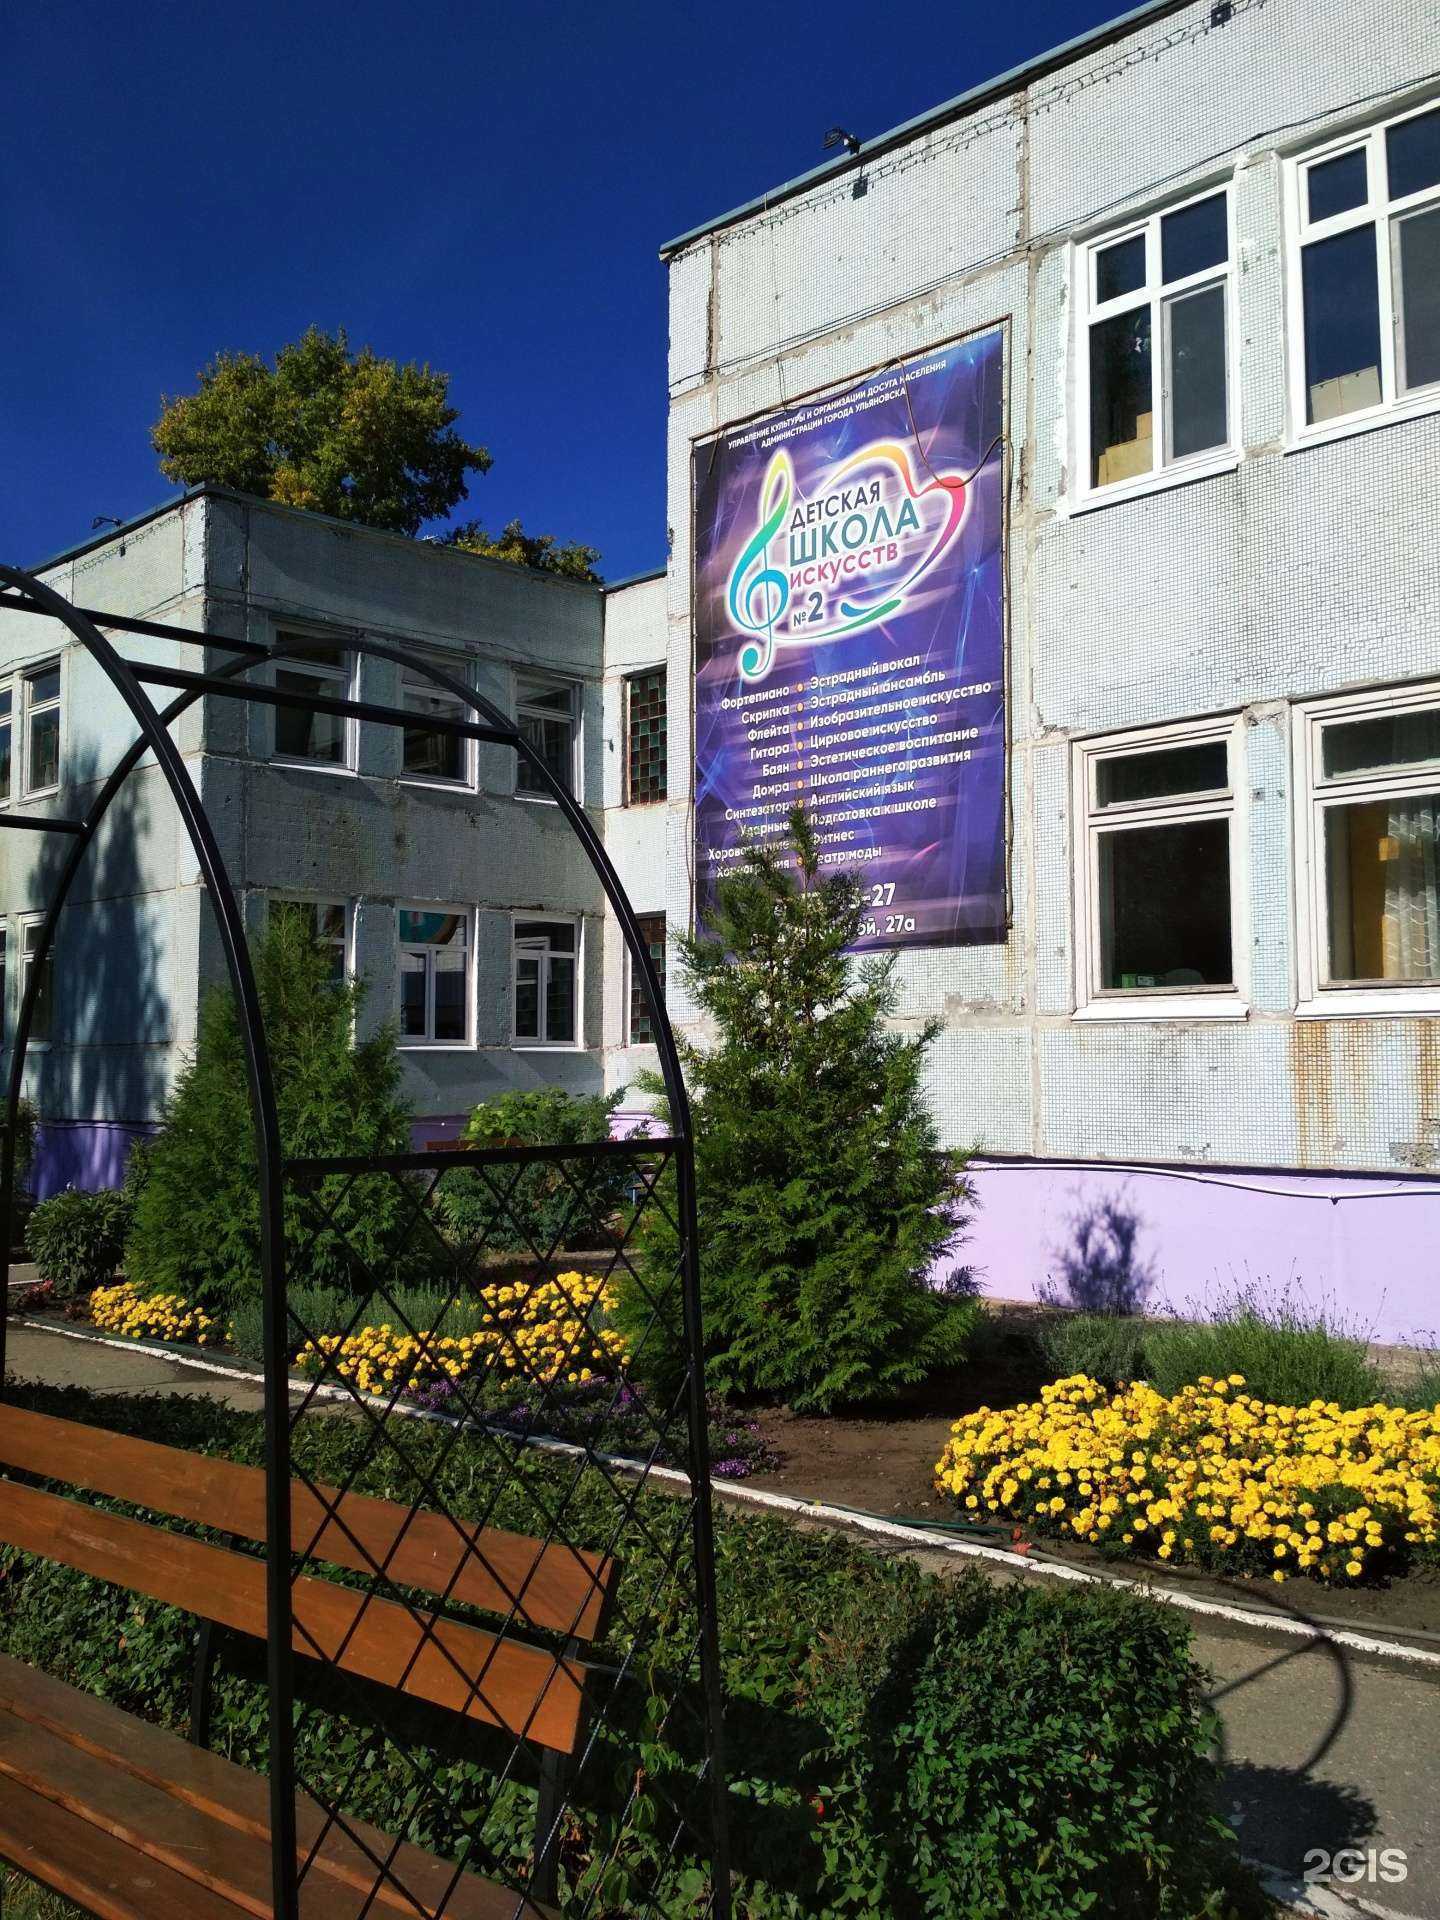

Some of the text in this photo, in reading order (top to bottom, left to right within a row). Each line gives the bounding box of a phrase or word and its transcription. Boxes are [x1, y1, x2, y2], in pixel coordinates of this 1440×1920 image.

[728, 359, 946, 449] УПРАВЛЕНИЕ КУЛЬТУРЫ И ОРГАНИЗАЦИИ ДОСУГА НАСЕЛЕНИЯ
[761, 387, 906, 448] АДМИНИСТРАЦИИ ГОРОДА УЛЬЯНОВСКА
[790, 481, 881, 532] ДЕТСКАЯ
[790, 498, 920, 567] ШКОЛА
[810, 655, 920, 690] Эстрадный вокал
[721, 686, 790, 710] Фортепиано
[810, 670, 946, 709] Эстрадный ансамбль
[741, 705, 790, 724] Скрипка
[810, 682, 992, 729] Изобразительное искусство
[747, 724, 790, 741] Флейта
[810, 713, 938, 750] Цирковое искусство
[750, 743, 790, 760] Гитара
[810, 726, 979, 768] Эстетическое воспитание
[762, 762, 790, 777] Баян
[810, 750, 971, 787] Школа раннего развития
[752, 782, 790, 800] Домра
[809, 779, 915, 807] Английский язык
[725, 801, 790, 821] Синтезатор
[810, 797, 937, 826] Подготовка к школе
[812, 846, 882, 865] еатр моды
[885, 914, 916, 933] 27а
